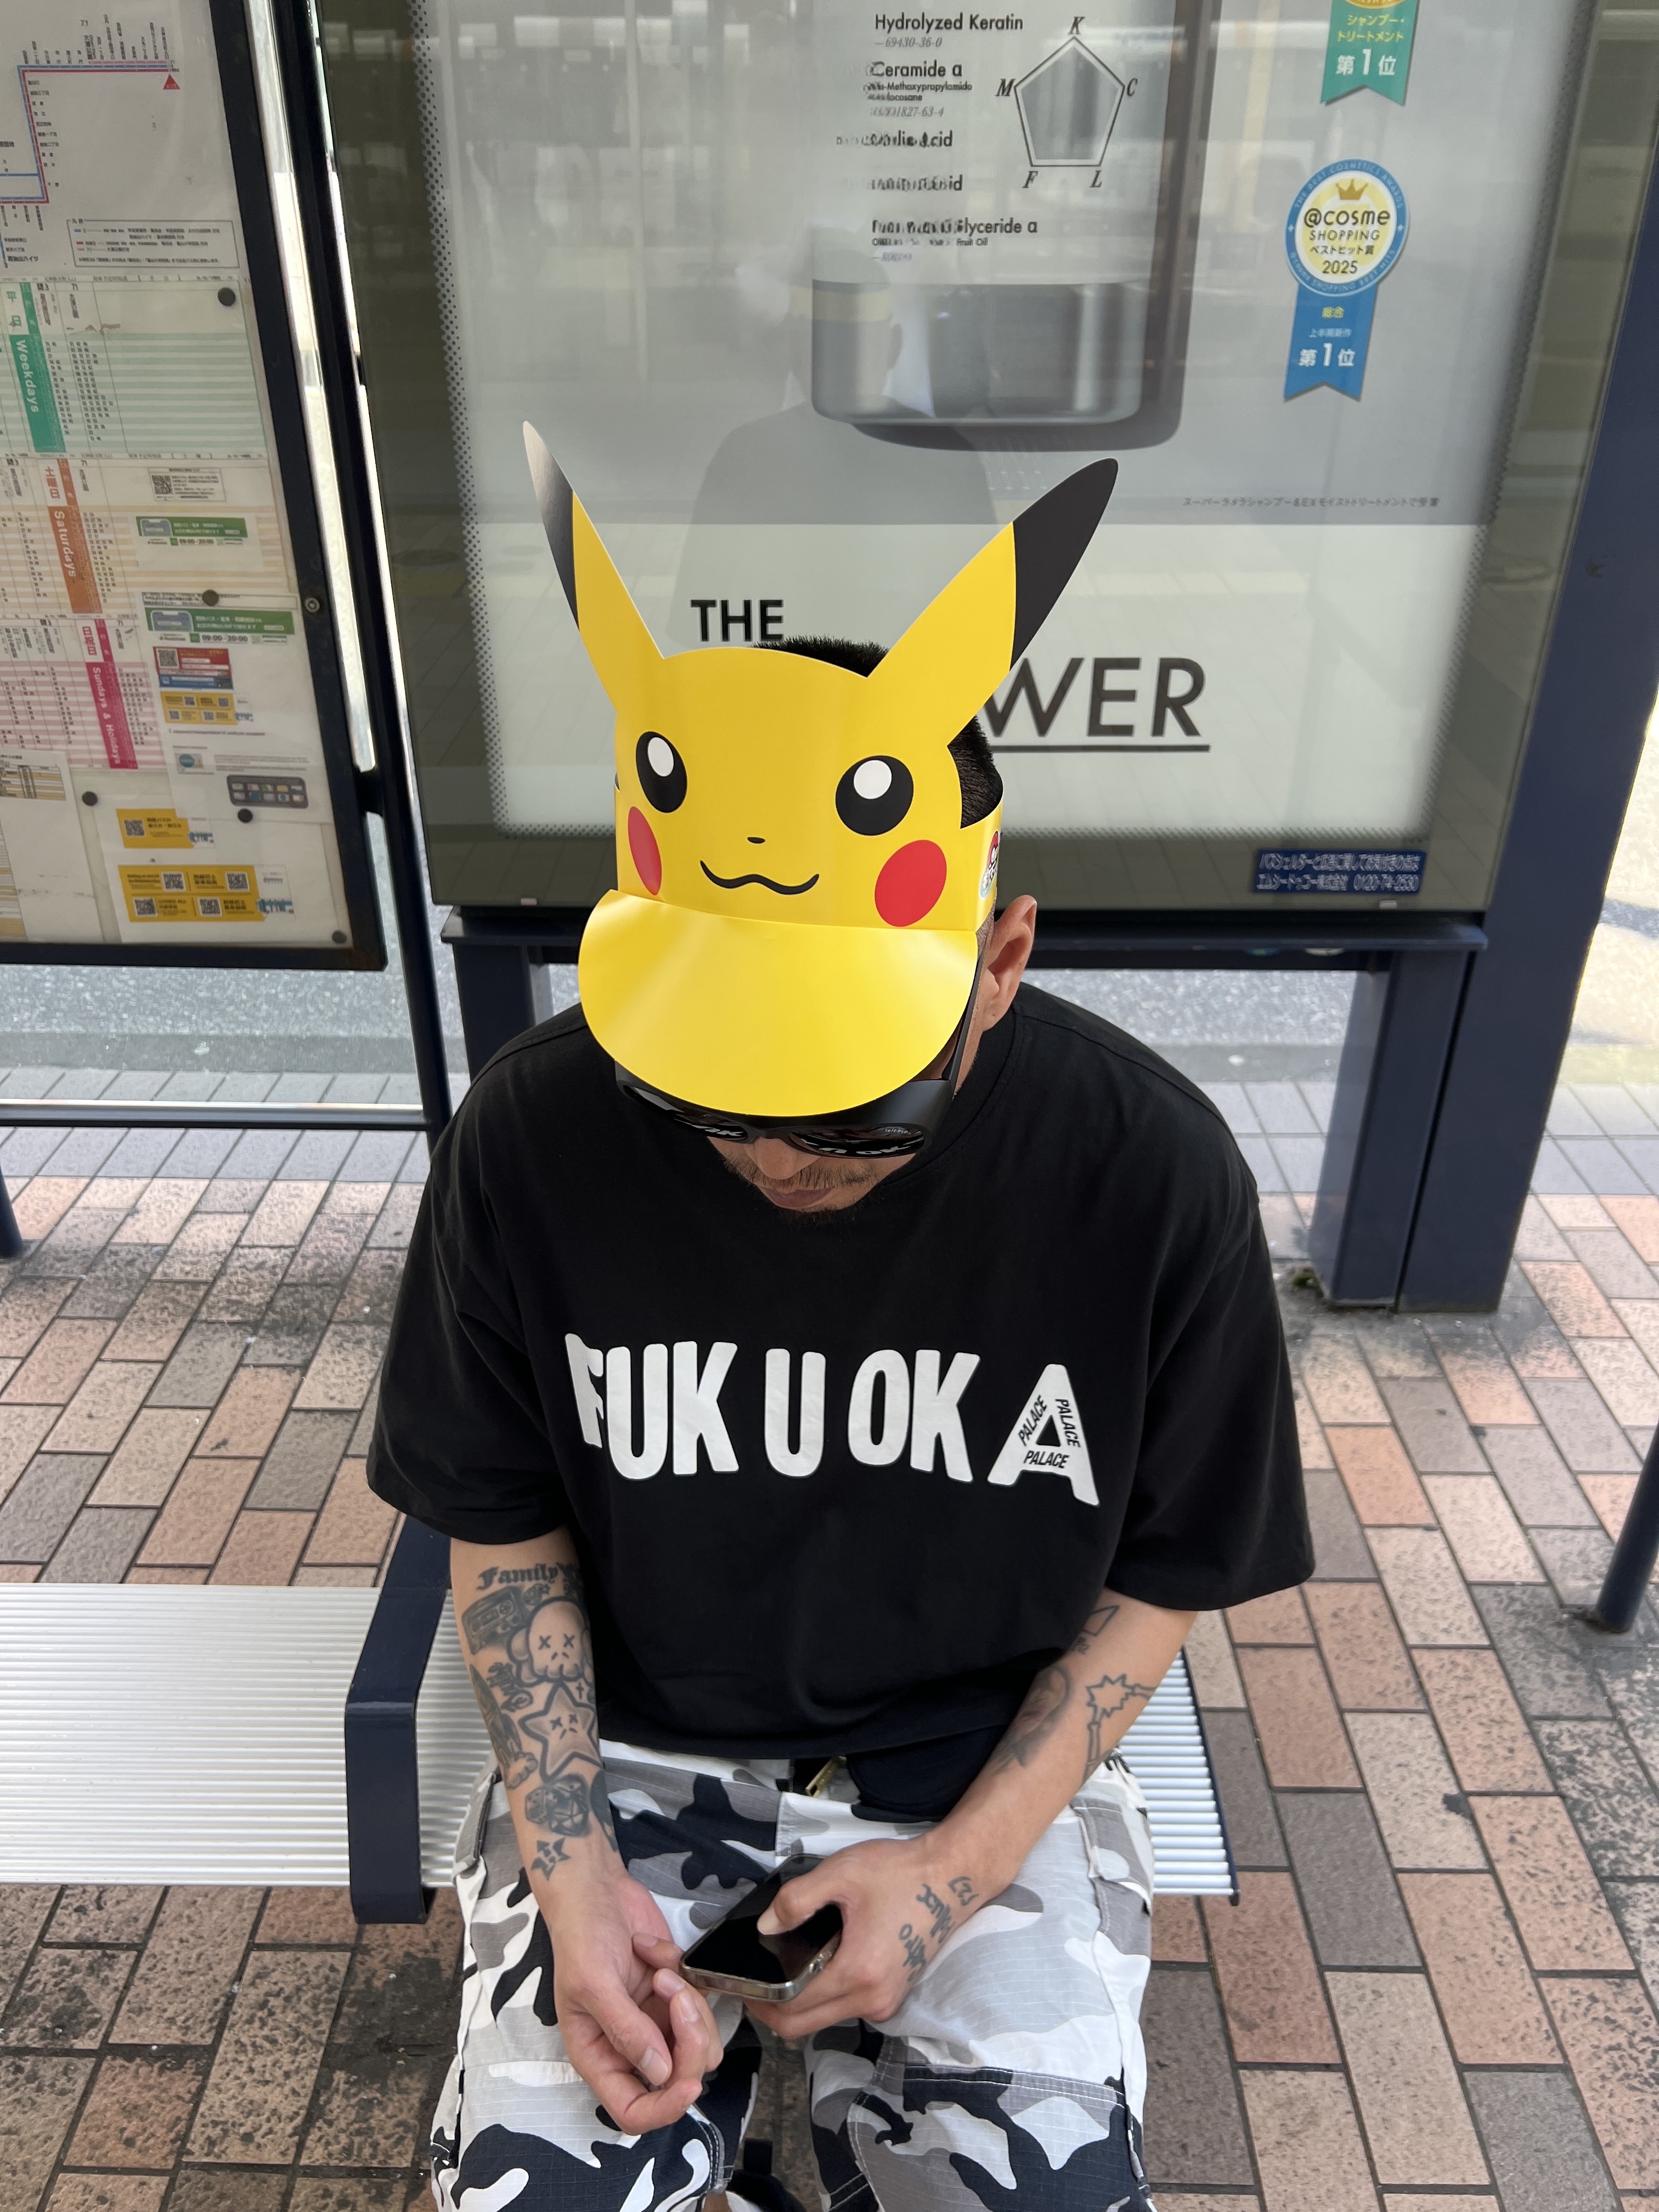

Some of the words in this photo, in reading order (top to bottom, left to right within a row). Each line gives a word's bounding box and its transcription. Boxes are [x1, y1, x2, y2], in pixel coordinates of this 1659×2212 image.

[875, 13, 962, 33] Hydrolyzed
[969, 14, 1023, 31] Keratin
[1069, 16, 1086, 35] K
[885, 37, 943, 48] 69430-36-0
[1337, 30, 1404, 42] トリートメント
[872, 60, 946, 78] Ceramide
[1335, 48, 1397, 75] 第1位
[995, 78, 1015, 97] M
[1126, 78, 1138, 97] C
[1022, 171, 1038, 188] F
[1090, 170, 1103, 188] L
[1304, 208, 1391, 228] @cosme
[1309, 230, 1380, 241] SHOPPING
[1310, 245, 1375, 255] ベストヒット賞
[1322, 260, 1358, 274] 2025
[1299, 342, 1356, 367] 第1位
[16, 339, 39, 413] Weekdays
[54, 510, 77, 578] Saturdays
[690, 599, 785, 642] THE
[1018, 1394, 1048, 1447] PALACE
[1054, 1398, 1081, 1448] PALACE
[1022, 1449, 1070, 1470] PALACE
